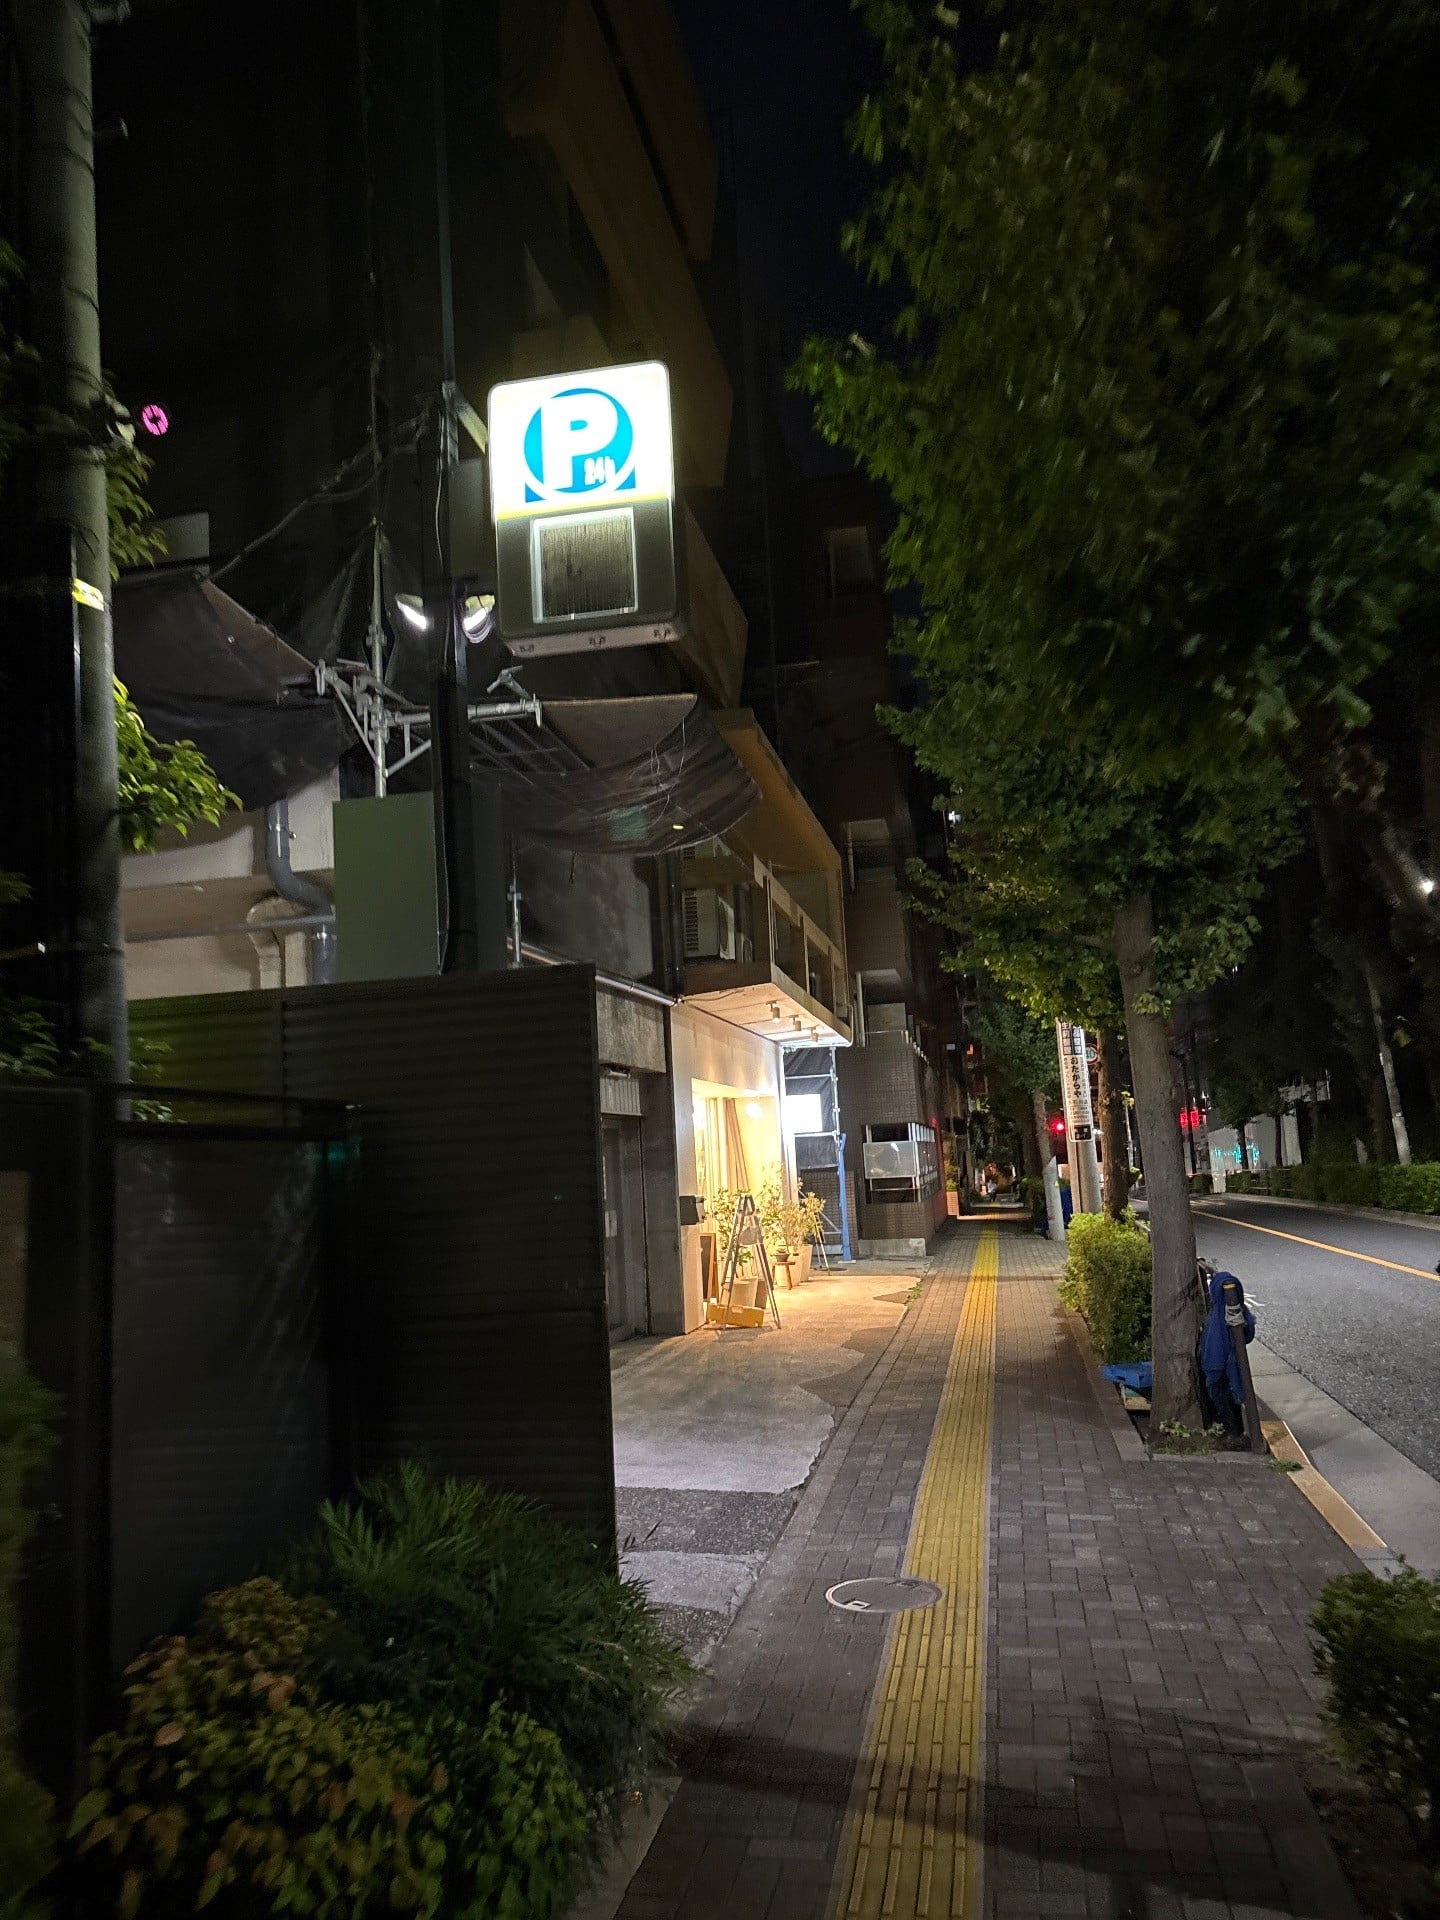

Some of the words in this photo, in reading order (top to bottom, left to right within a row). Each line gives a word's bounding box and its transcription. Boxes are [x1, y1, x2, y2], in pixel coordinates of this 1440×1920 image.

[541, 393, 618, 489] P
[1070, 1057, 1082, 1098] おたからや
